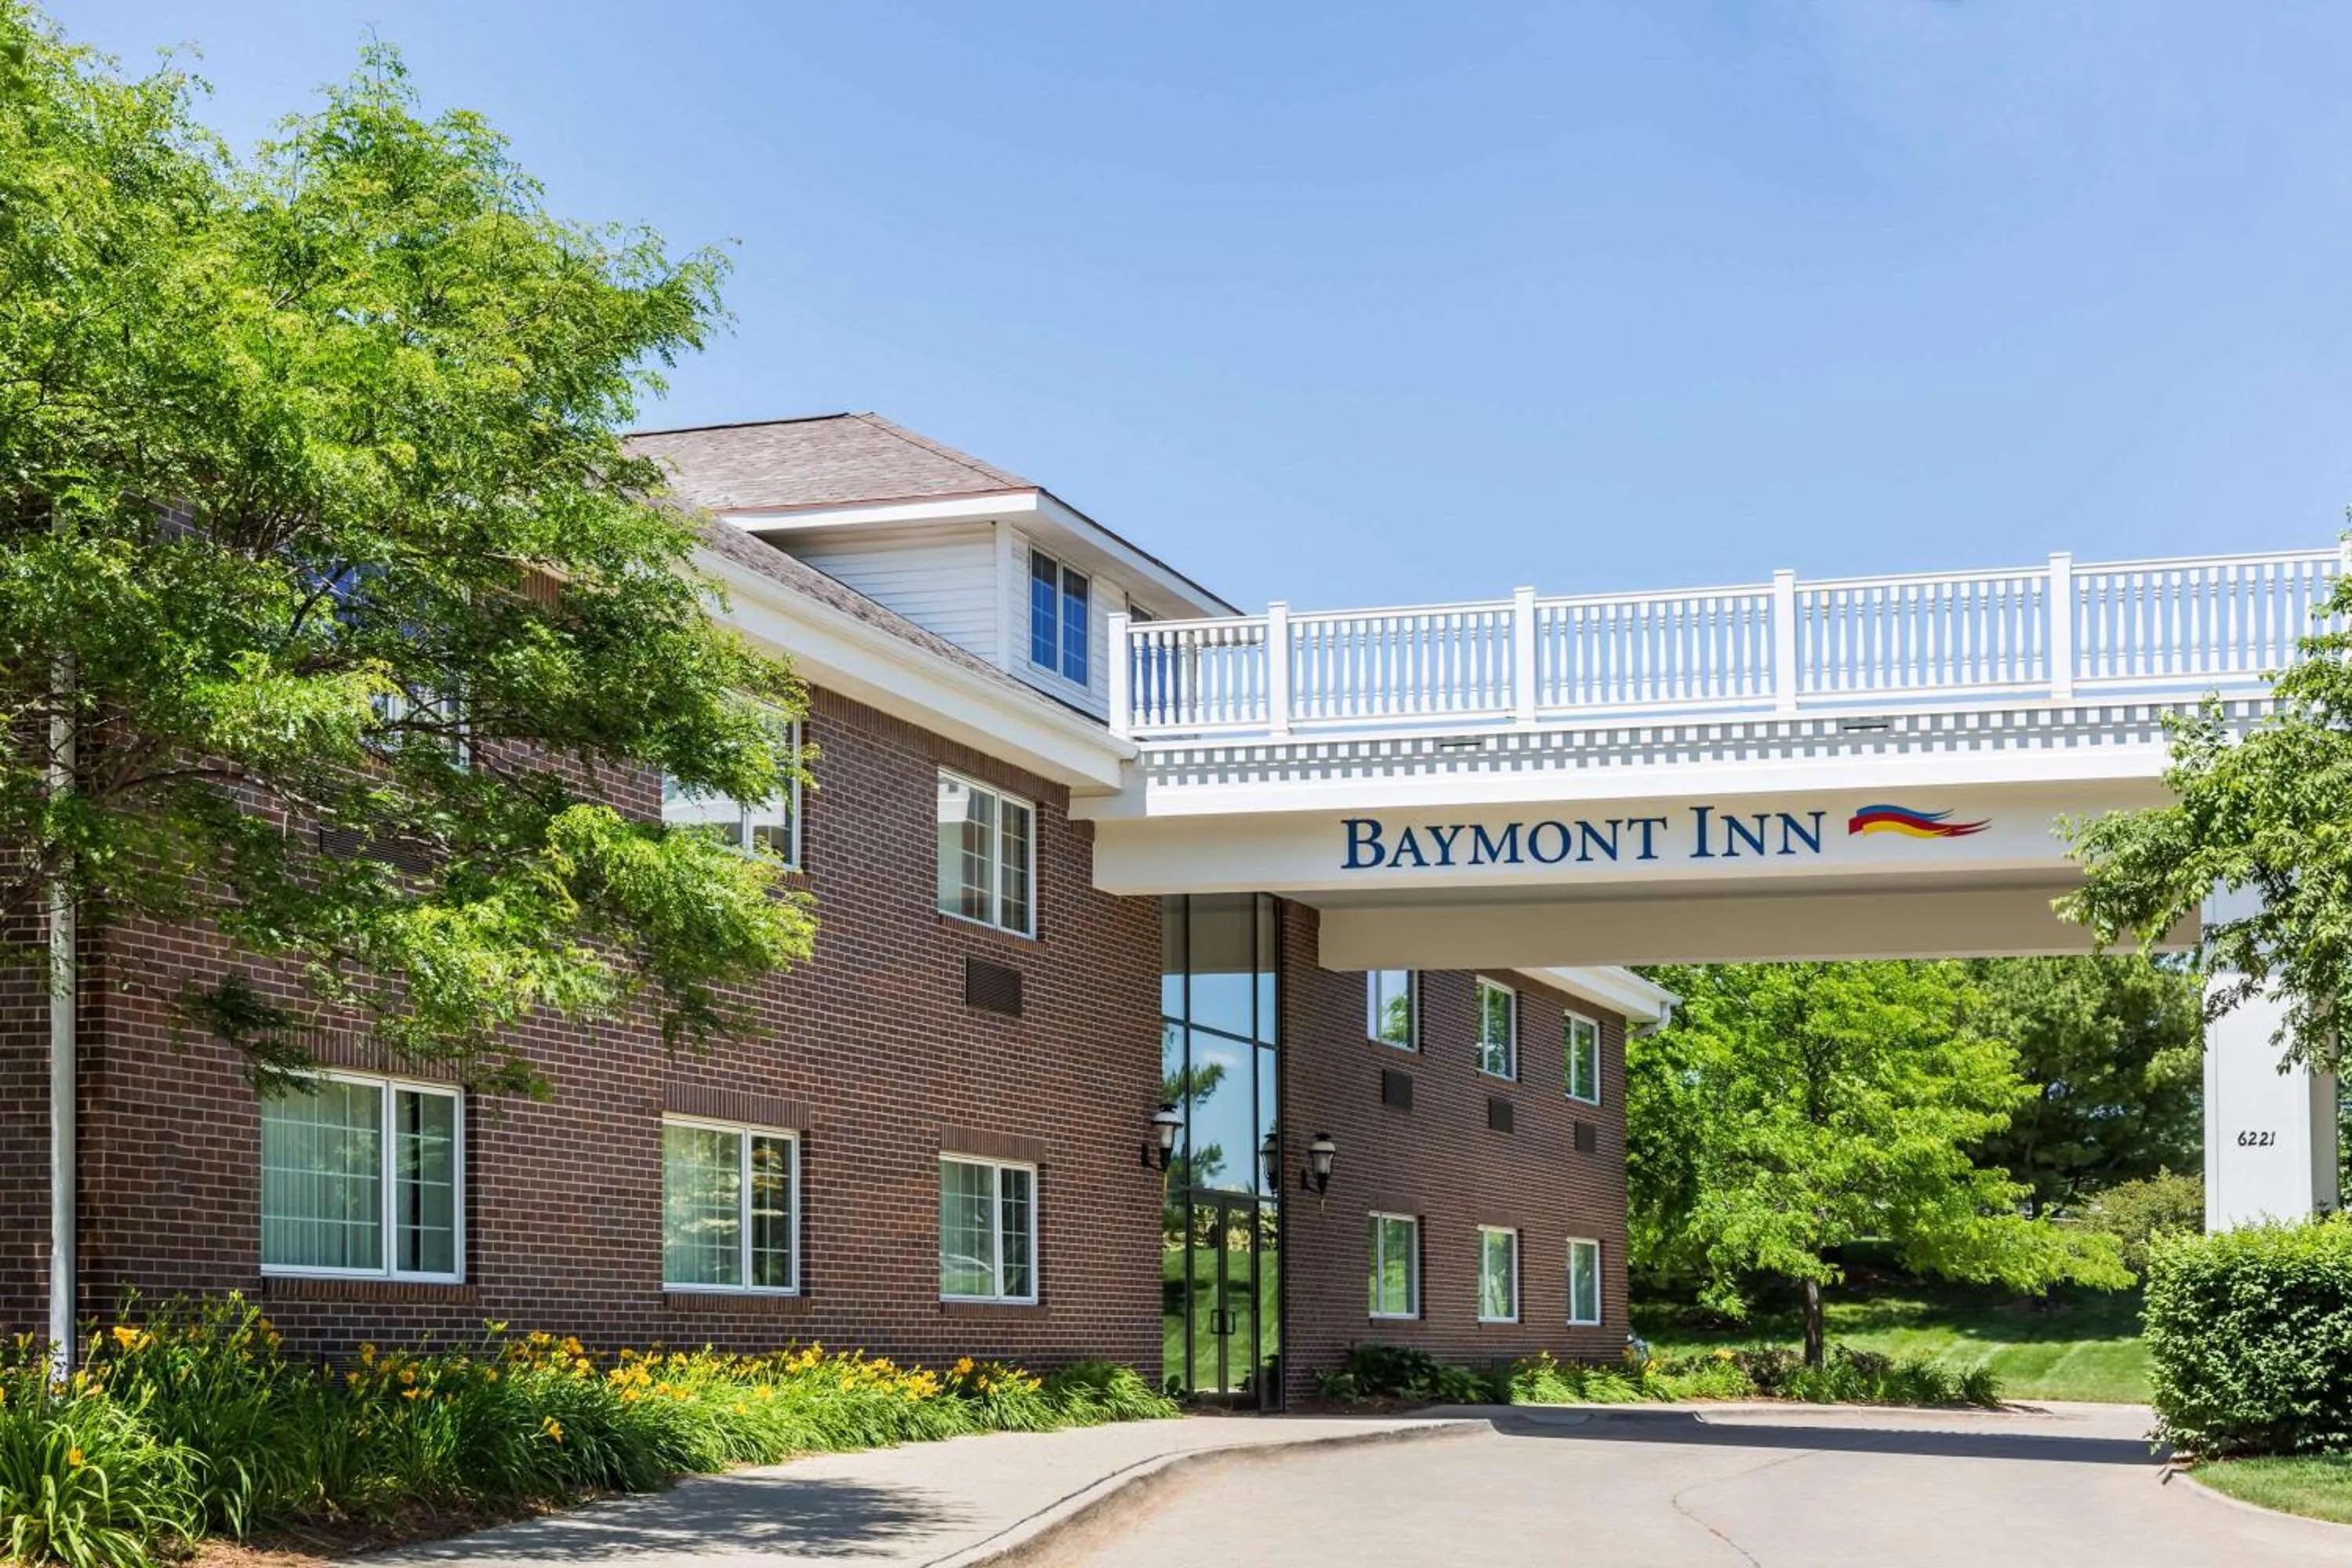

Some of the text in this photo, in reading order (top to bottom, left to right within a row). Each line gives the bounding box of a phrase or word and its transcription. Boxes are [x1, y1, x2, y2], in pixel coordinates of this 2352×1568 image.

[1341, 806, 1827, 869] BAYMONT INN
[2237, 1130, 2276, 1147] 6221
